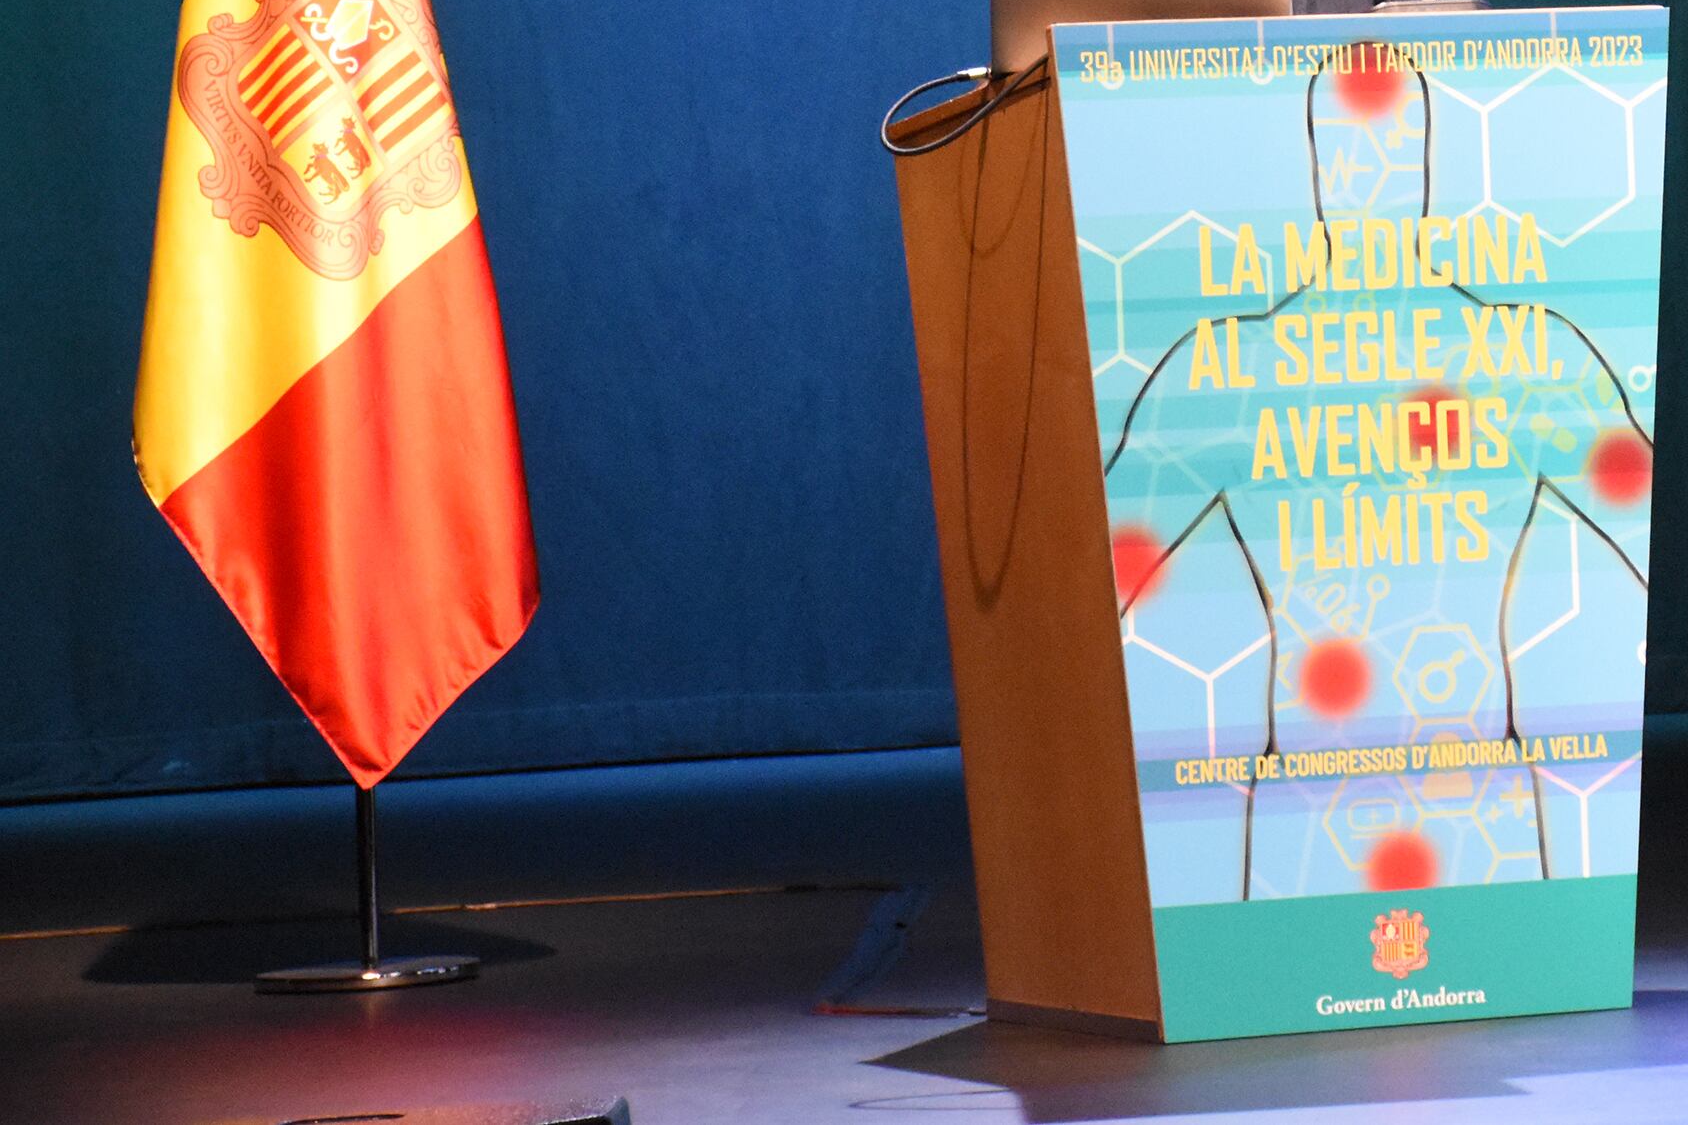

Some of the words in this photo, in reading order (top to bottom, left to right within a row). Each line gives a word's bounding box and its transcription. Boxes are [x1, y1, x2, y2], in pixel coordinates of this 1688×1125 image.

[1129, 46, 1266, 82] UNIVERSITAT
[1273, 43, 1353, 77] D'ESTIU
[1360, 43, 1366, 74] I
[1372, 39, 1456, 74] TARDOR
[1463, 36, 1583, 72] D'ANDORRA
[1588, 35, 1643, 67] 2023
[271, 190, 335, 246] FORTIOR
[1199, 223, 1265, 296] LA
[1285, 213, 1547, 291] MEDICINA
[1188, 317, 1256, 390] AL
[1274, 308, 1444, 386] SEGLE
[1460, 304, 1565, 380] XXI,
[1251, 397, 1509, 489] AVENÇOS
[1277, 500, 1292, 571] I
[1312, 482, 1490, 570] LÍMITS
[1175, 755, 1250, 784] CENTRE
[1255, 754, 1280, 780] DE
[1284, 746, 1407, 777] CONGRESSOS
[1412, 739, 1516, 770] D'ANDORRA
[1521, 737, 1545, 763] LA
[1549, 733, 1608, 761] VELLA
[1316, 992, 1386, 1016] Govern
[1391, 986, 1486, 1010] d'Andorra
